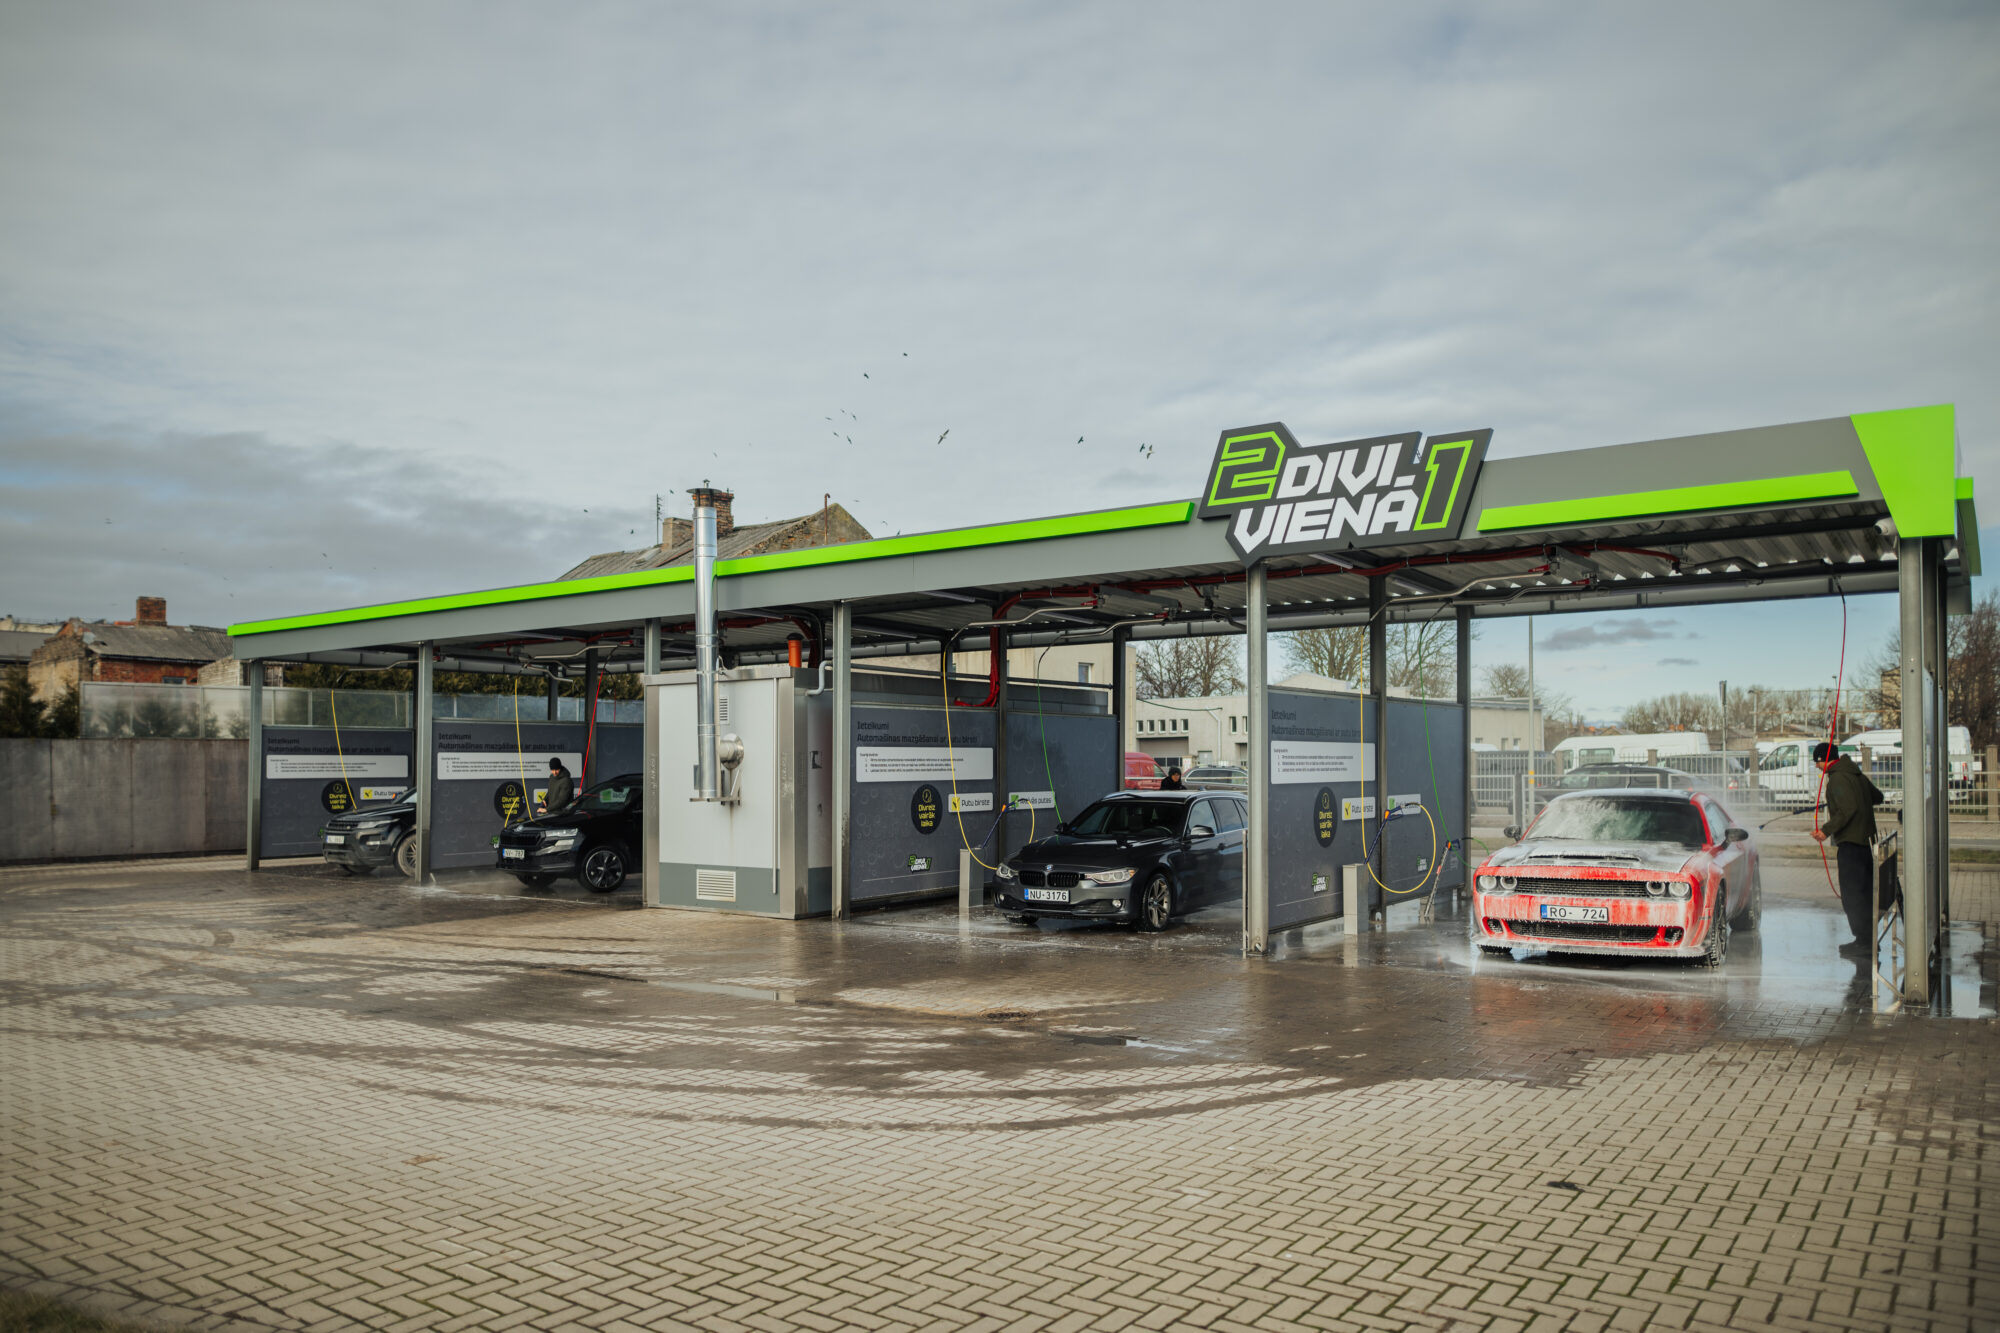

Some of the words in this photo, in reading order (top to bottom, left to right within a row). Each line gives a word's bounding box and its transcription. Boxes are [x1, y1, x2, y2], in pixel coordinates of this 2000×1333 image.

[1207, 430, 1286, 507] 2
[1276, 442, 1403, 499] DIVI
[1413, 439, 1474, 532] 1
[1029, 889, 1067, 901] NU-3176
[1582, 908, 1606, 920] 724
